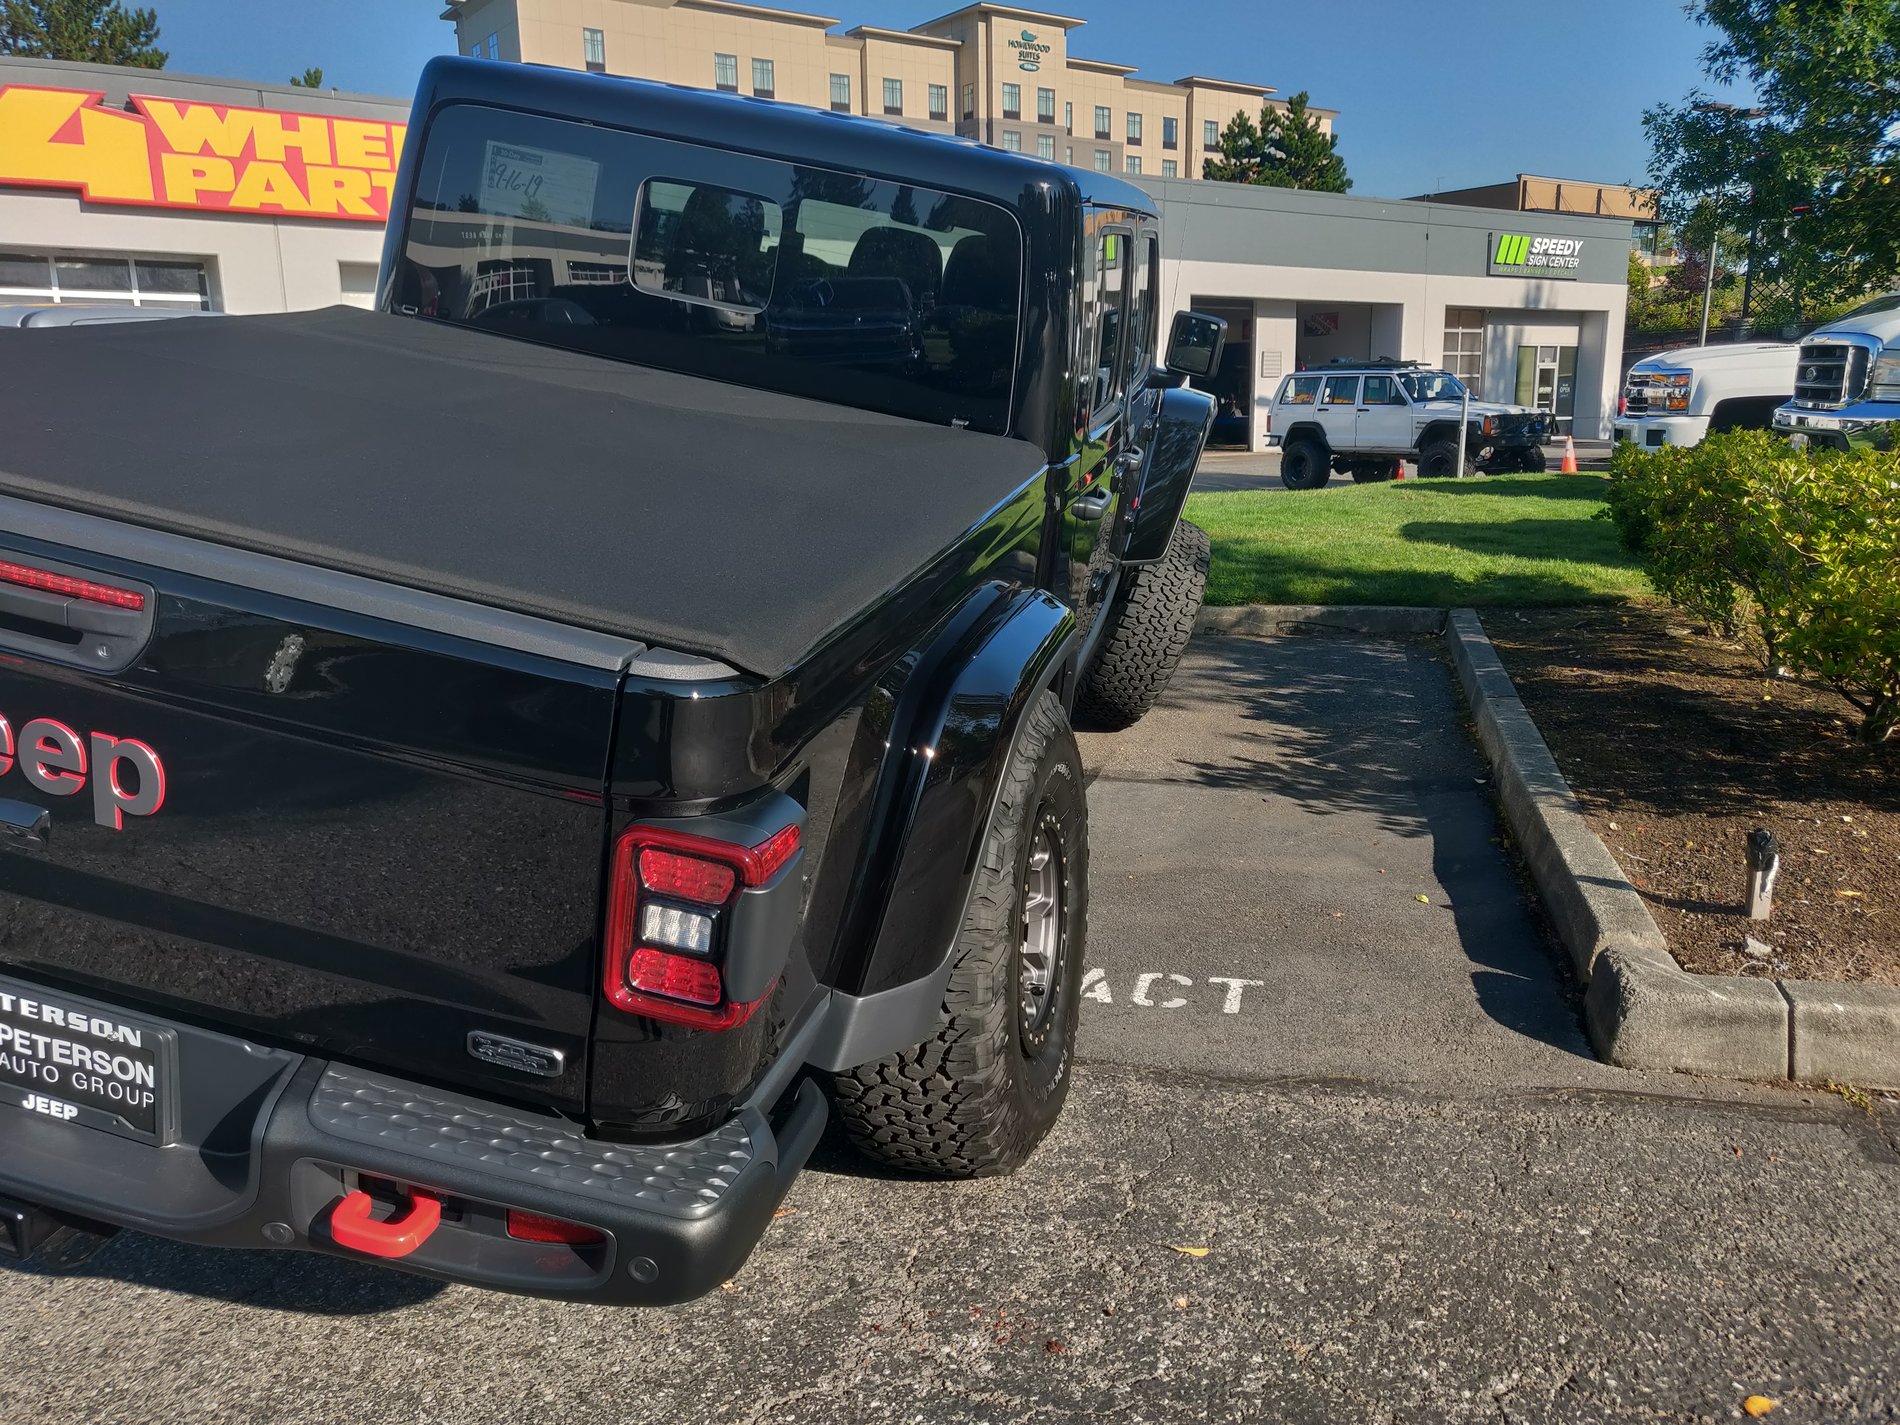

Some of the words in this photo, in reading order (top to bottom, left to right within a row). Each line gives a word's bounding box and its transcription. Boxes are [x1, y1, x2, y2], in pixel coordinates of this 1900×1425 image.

[1008, 39, 1051, 53] HOMEWOOD
[1018, 51, 1041, 60] SUITES
[0, 87, 155, 200] 4
[141, 100, 407, 171] WHE
[1531, 237, 1584, 256] SPEEDY
[1528, 255, 1548, 267] SIGN
[1549, 256, 1580, 268] CENTER
[0, 1023, 154, 1088] PETERSON
[0, 1052, 59, 1083] AUTO
[72, 1072, 154, 1108] GROUP
[22, 1094, 79, 1120] JEEP
